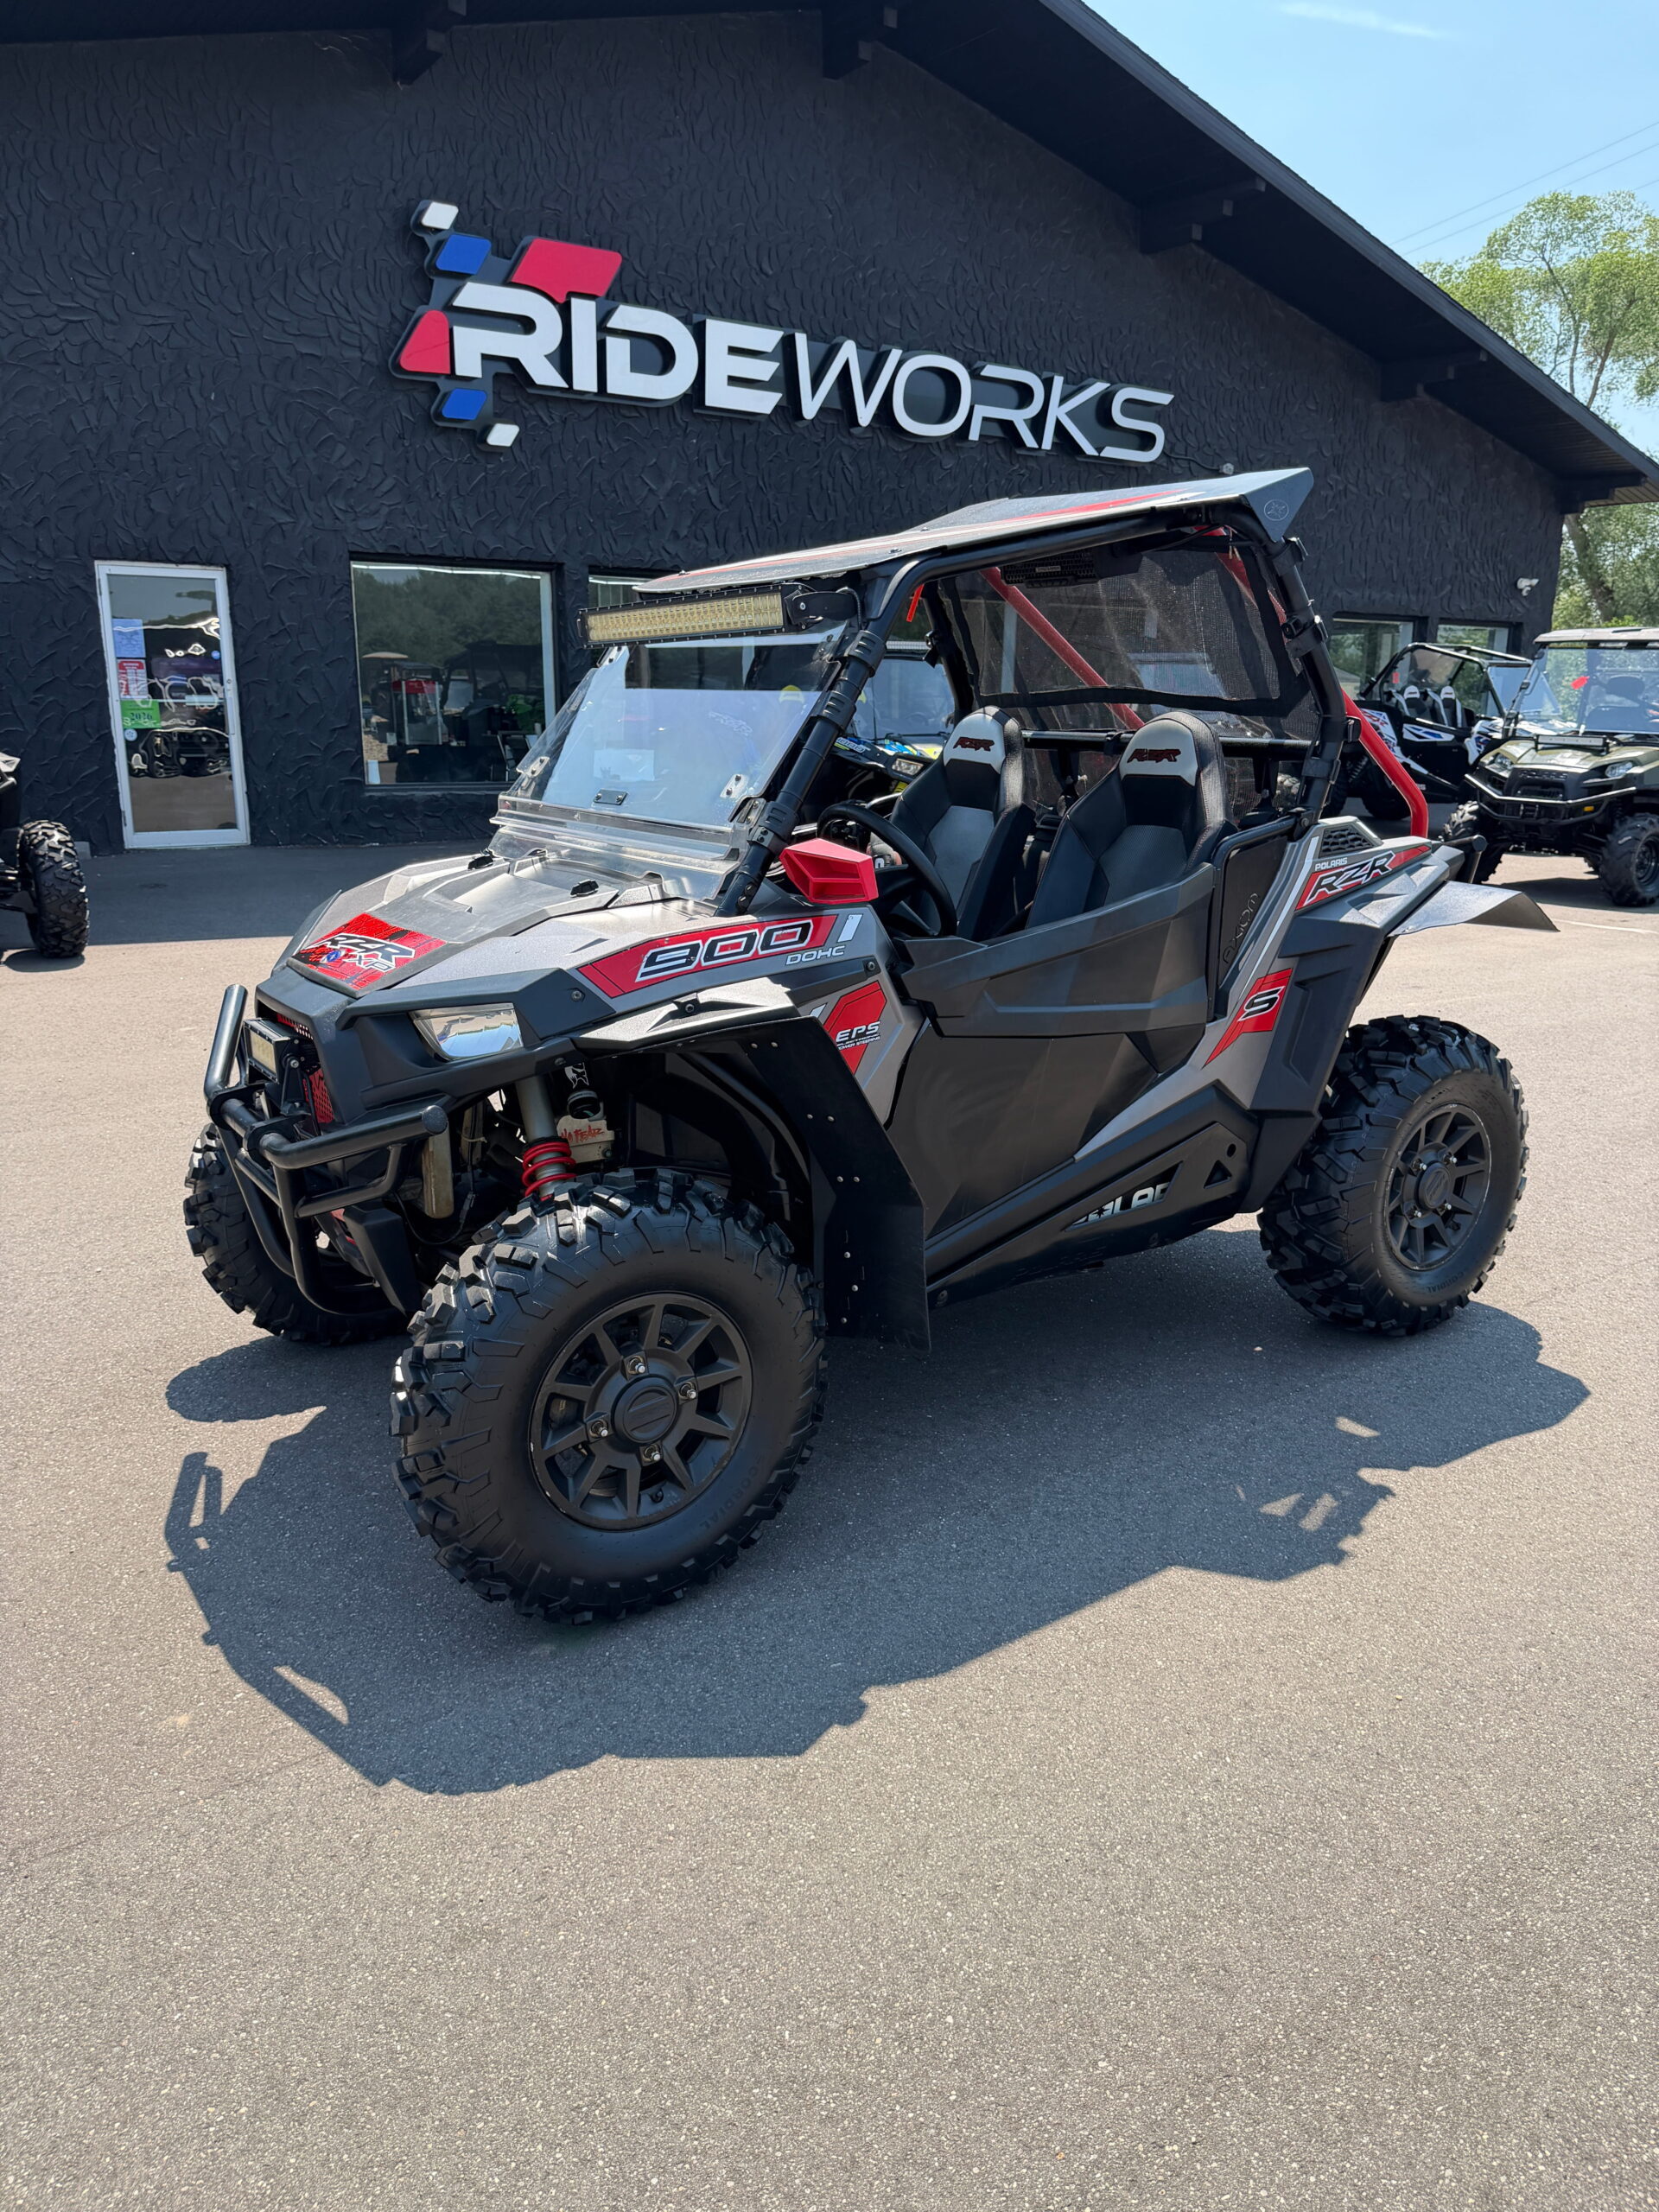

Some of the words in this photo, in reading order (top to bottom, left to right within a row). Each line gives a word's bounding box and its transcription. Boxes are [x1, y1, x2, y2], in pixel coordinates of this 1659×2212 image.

[451, 282, 1175, 463] RIDEWORKS
[130, 712, 153, 721] 2026
[1303, 850, 1395, 906] RZR
[1314, 857, 1348, 872] POLARIS
[305, 932, 416, 967] RZR
[342, 953, 397, 973] XP
[634, 919, 814, 983] 900
[785, 945, 846, 967] DOHC
[1237, 985, 1286, 1021] S
[836, 1020, 880, 1043] EPS
[1425, 1270, 1465, 1294] CORDIAL
[697, 1465, 760, 1529] CORDIAL
